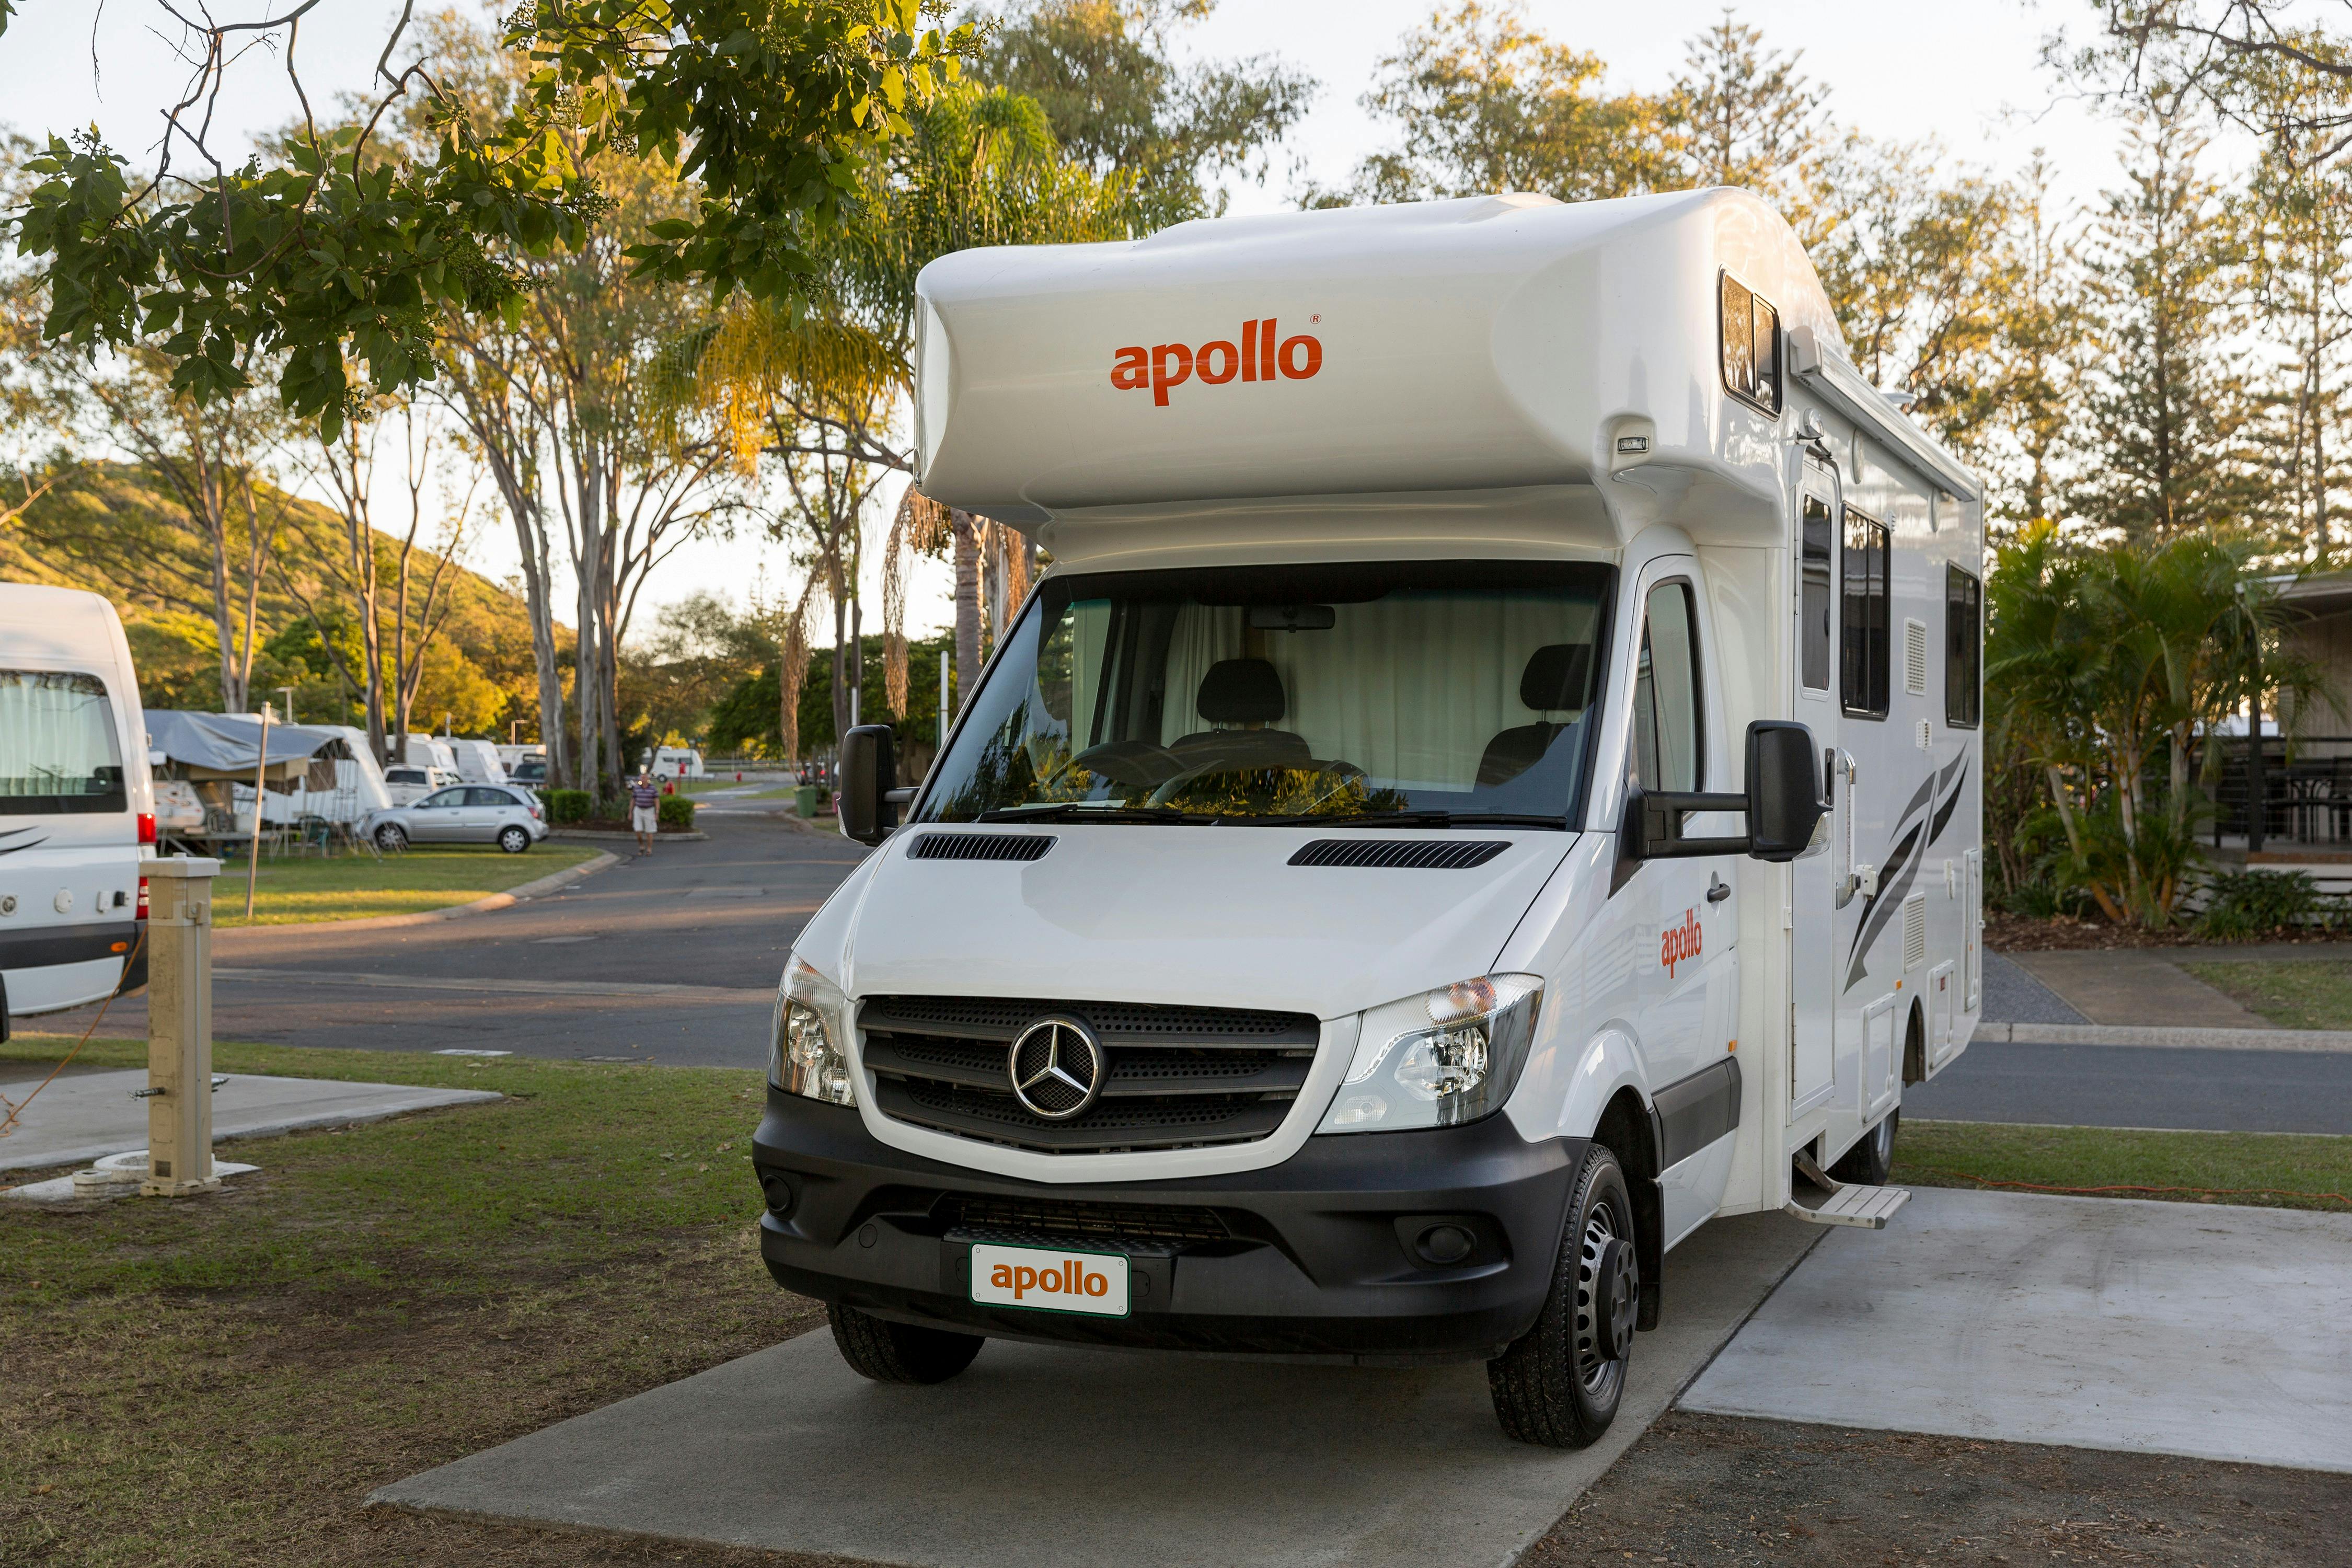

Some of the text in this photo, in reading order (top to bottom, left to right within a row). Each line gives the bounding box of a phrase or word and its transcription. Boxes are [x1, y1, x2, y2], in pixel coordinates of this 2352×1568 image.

[1110, 317, 1322, 407] apollo
[1661, 907, 1702, 979] apollo
[990, 1260, 1109, 1299] apollo
